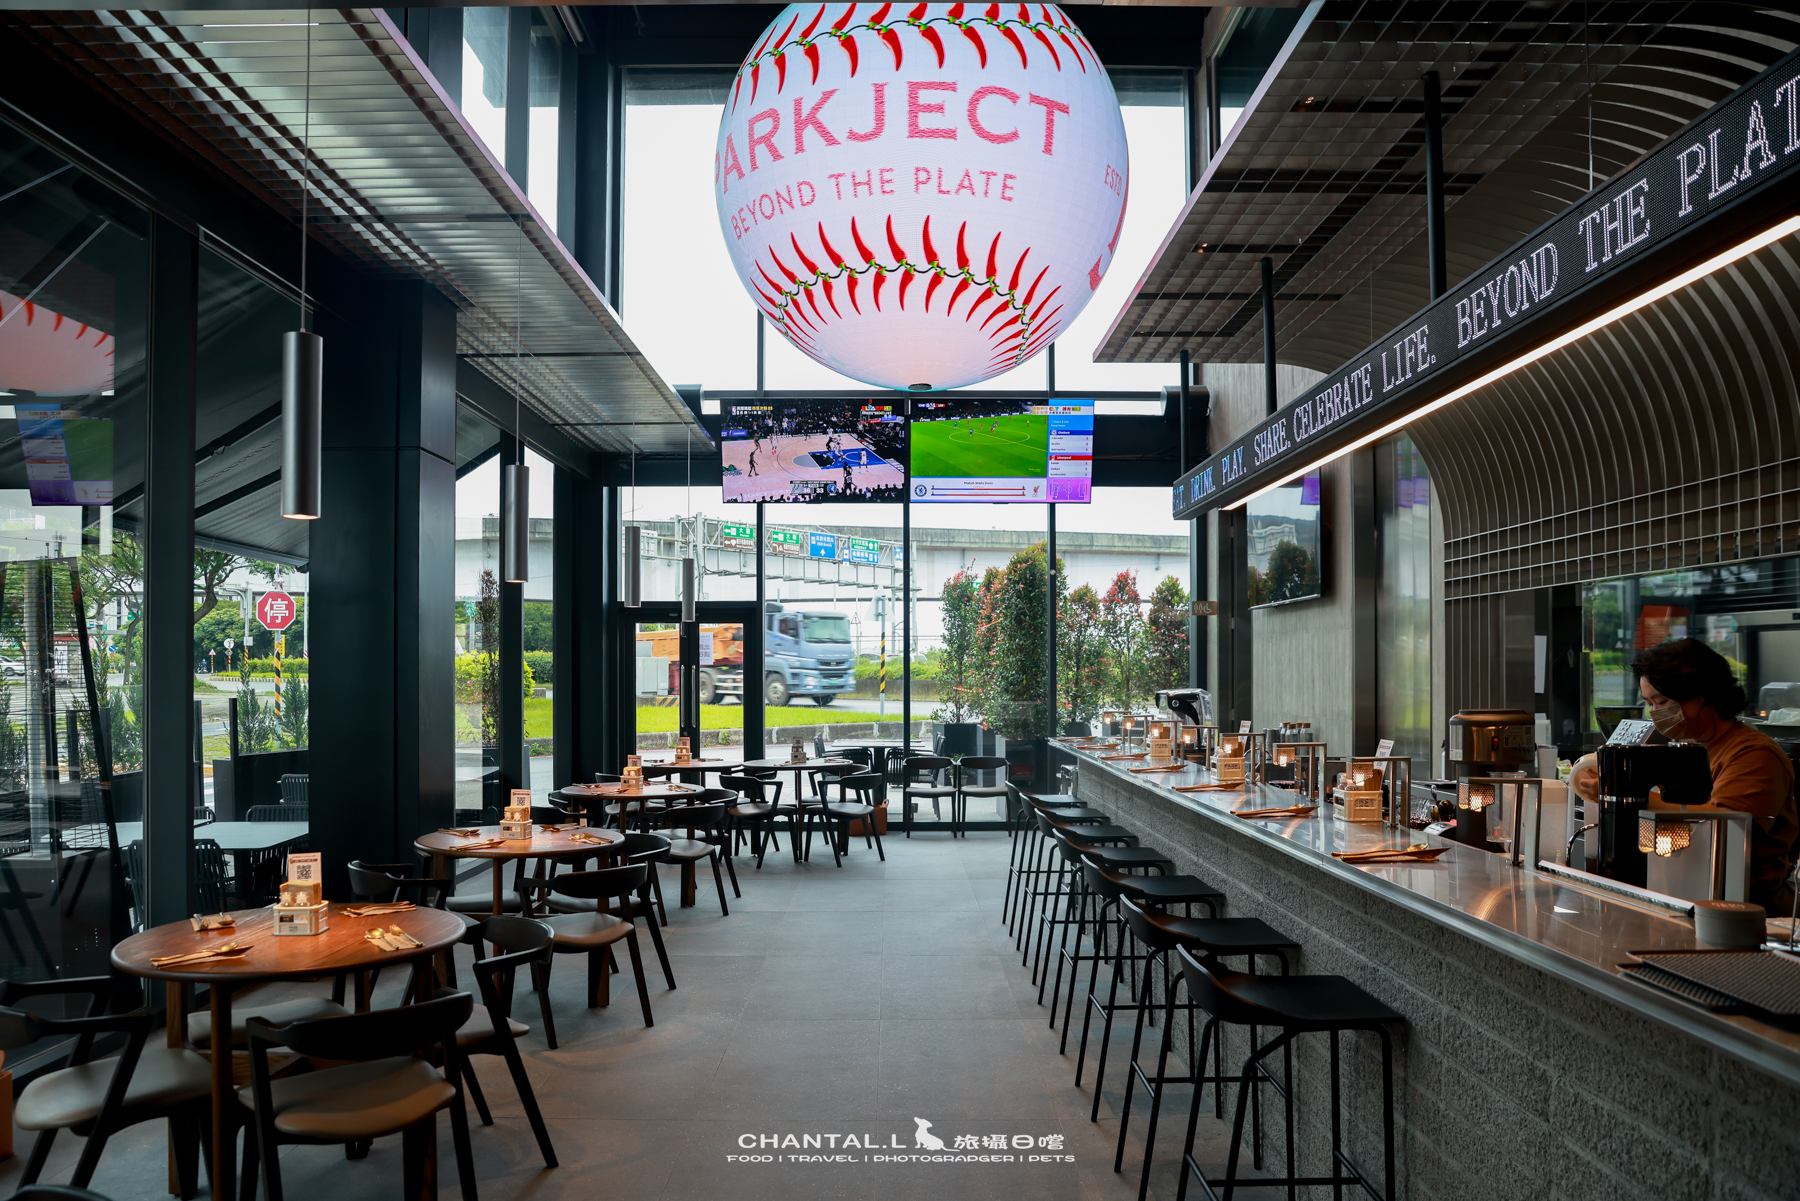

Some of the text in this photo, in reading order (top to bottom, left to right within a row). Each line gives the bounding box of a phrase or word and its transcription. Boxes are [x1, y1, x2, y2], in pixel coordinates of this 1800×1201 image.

[730, 166, 1017, 240] BEYOND THE PLATE
[1190, 466, 1216, 503] DRINK.
[1221, 445, 1247, 485] PLAY.
[1254, 418, 1291, 466] SHARE.
[1293, 362, 1373, 442] CELEBRATE
[1381, 324, 1436, 393] LIFE.
[1455, 242, 1559, 349] BEYOND
[1578, 178, 1650, 273] THE
[264, 598, 289, 624] 停
